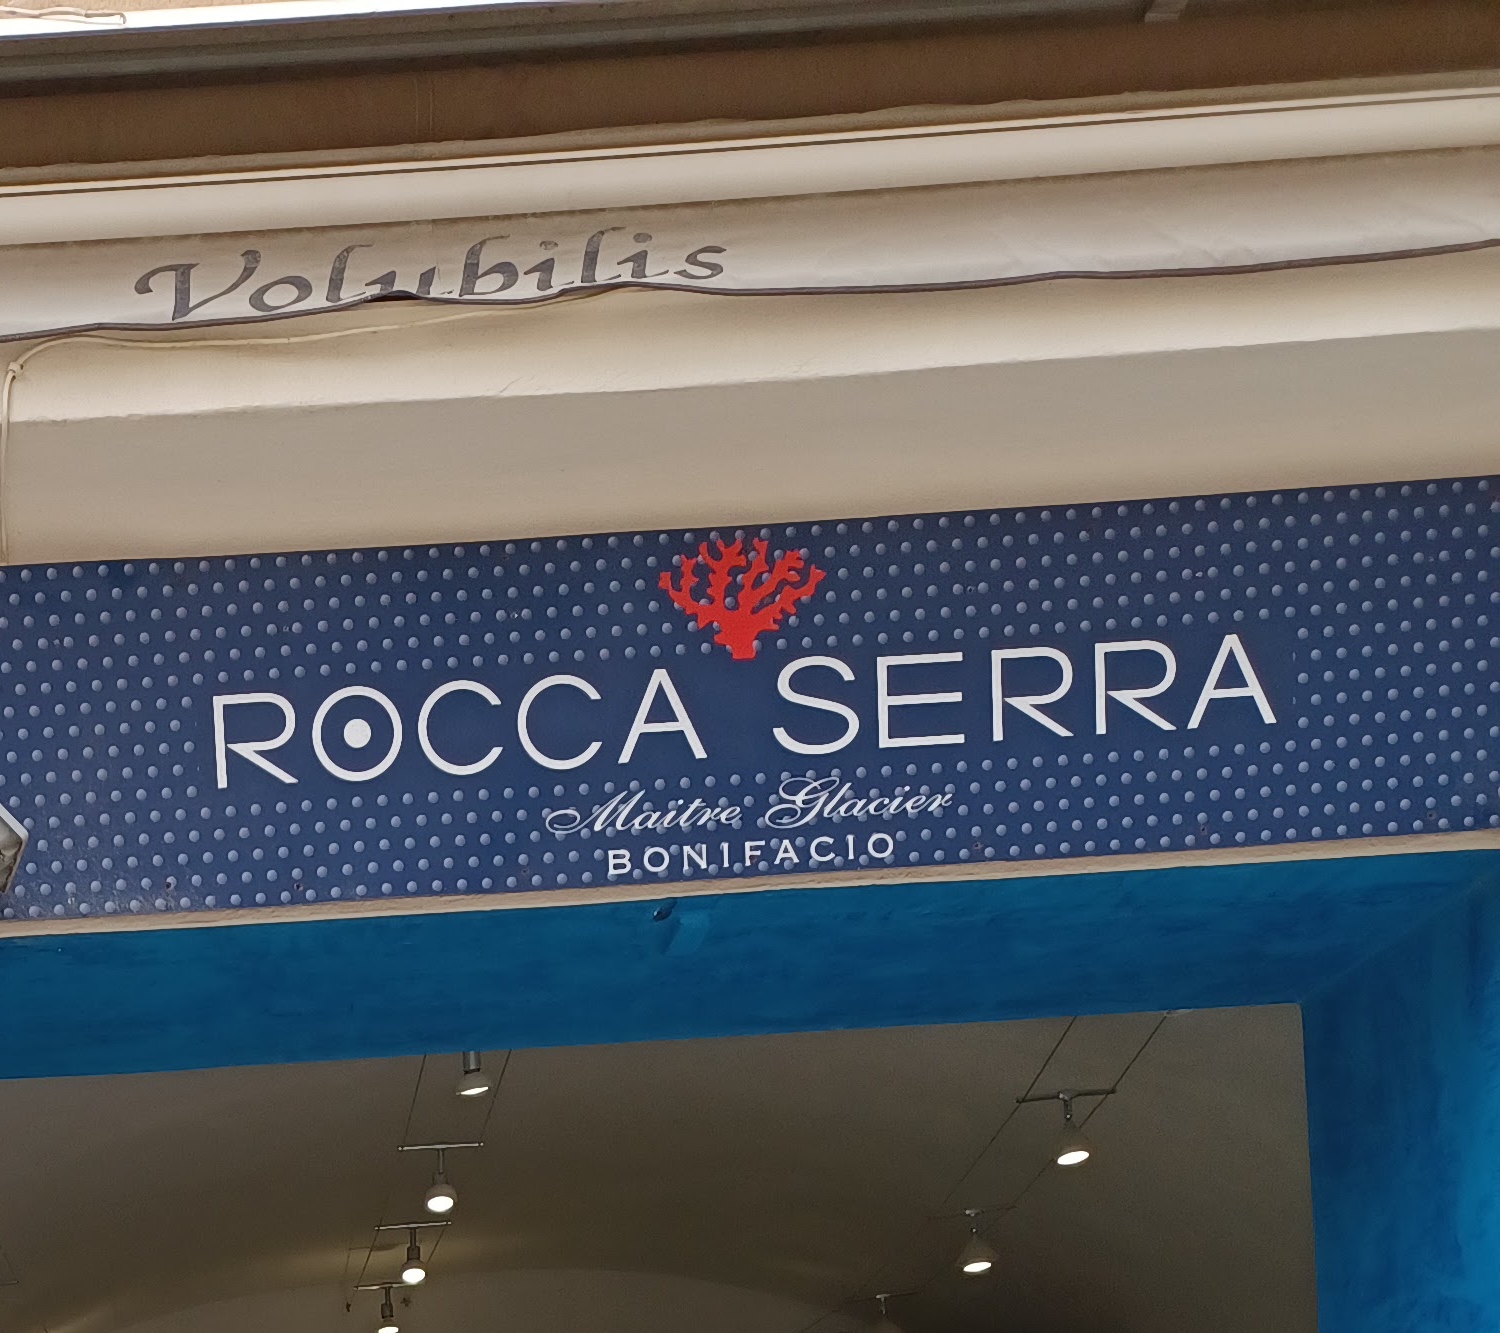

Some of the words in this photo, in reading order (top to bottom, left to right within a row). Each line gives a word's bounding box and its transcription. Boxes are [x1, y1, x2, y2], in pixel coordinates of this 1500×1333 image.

[134, 226, 727, 322] Volubilis
[212, 668, 707, 788] ROCCA
[772, 634, 1277, 755] SERRA
[764, 776, 953, 829] Glacier
[607, 832, 894, 875] BONIFACIO
